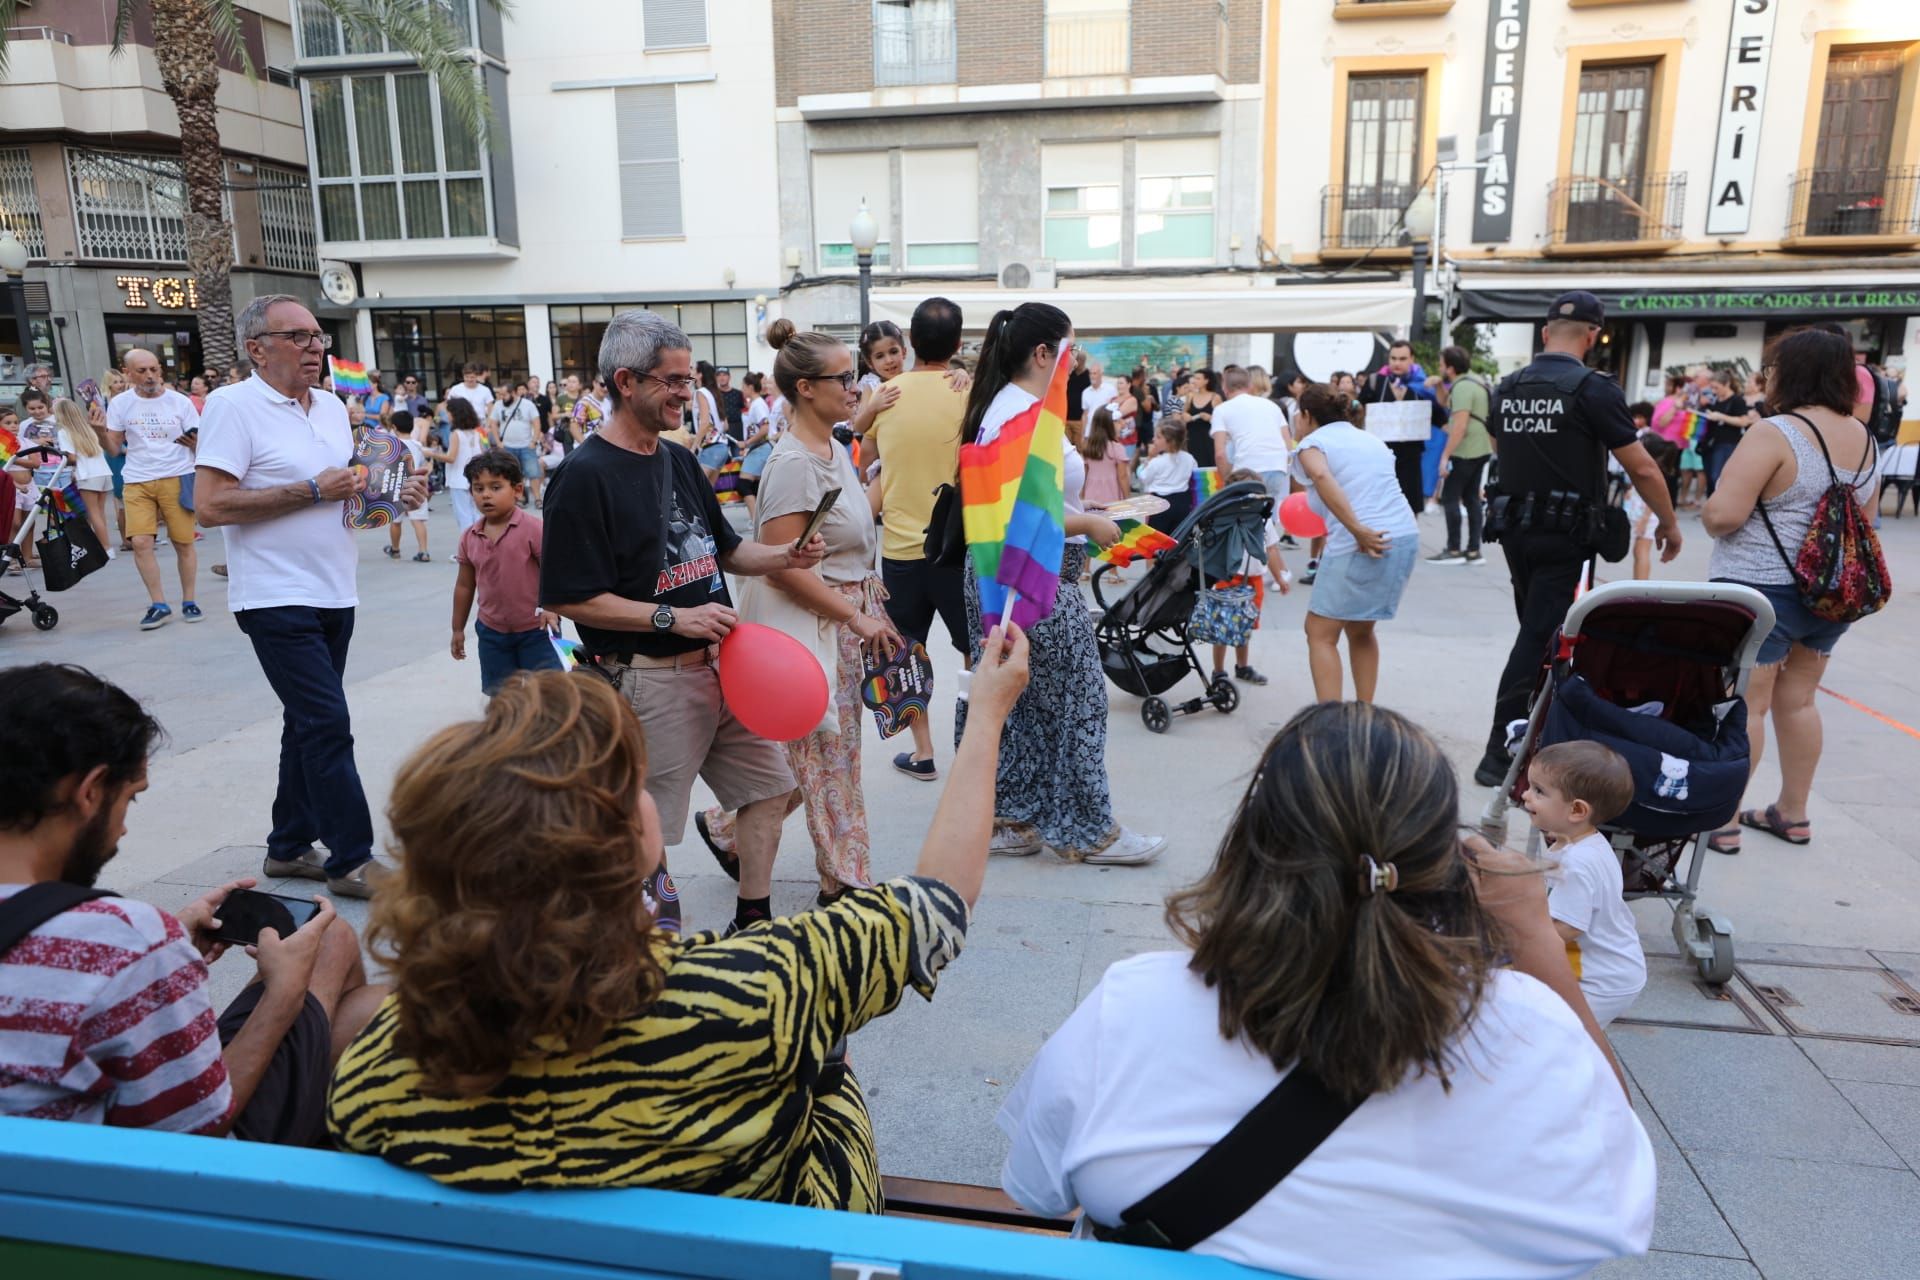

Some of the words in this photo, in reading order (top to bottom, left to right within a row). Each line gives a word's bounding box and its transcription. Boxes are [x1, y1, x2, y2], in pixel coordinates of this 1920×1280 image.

[1619, 294, 1694, 309] CARNES
[1699, 293, 1711, 308] Y
[1714, 292, 1813, 309] PESCADOS
[1818, 292, 1829, 308] A
[1834, 292, 1859, 308] LA
[1864, 290, 1920, 307] BRAS
[1500, 398, 1564, 414] POLICIA
[1503, 417, 1558, 433] LOCAL
[653, 553, 719, 597] AZINGER
